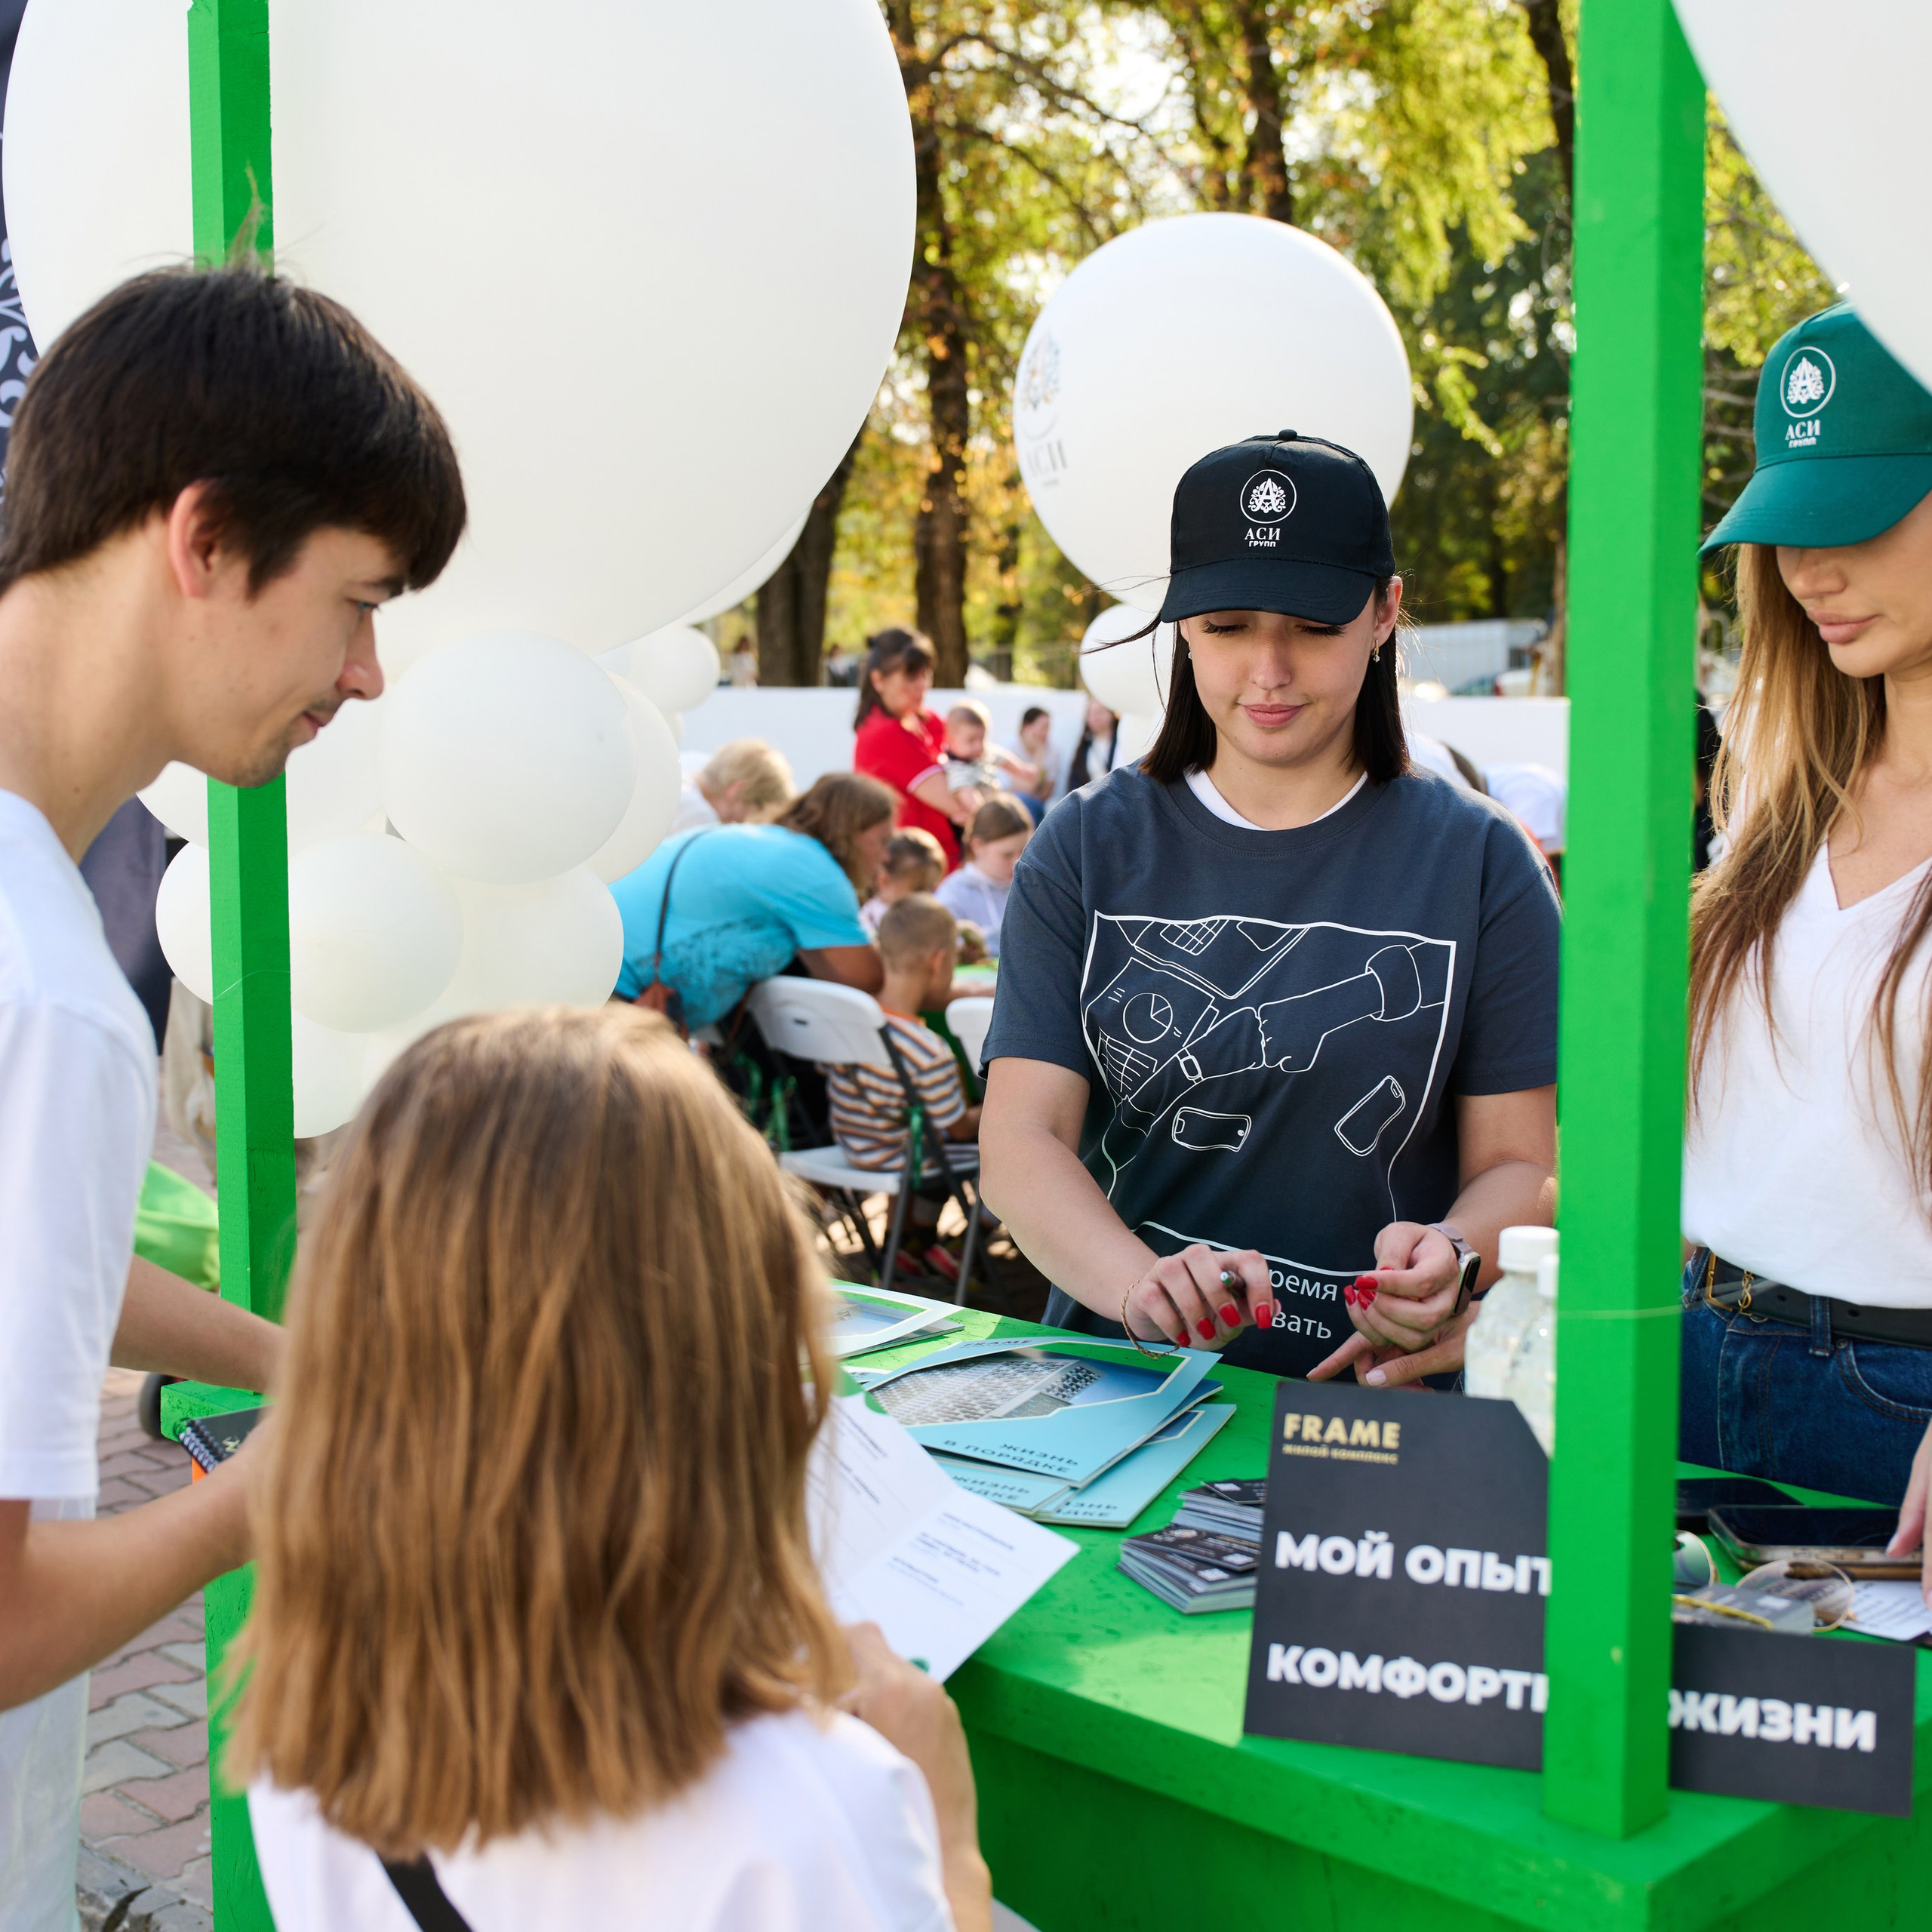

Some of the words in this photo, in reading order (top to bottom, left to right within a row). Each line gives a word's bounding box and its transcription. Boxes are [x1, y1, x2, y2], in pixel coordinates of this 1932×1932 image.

[1785, 419, 1821, 440] АСИ
[1244, 528, 1281, 540] АСИ
[1269, 1269, 1337, 1301] ремя
[1272, 1312, 1332, 1340] вать
[1283, 1413, 1401, 1450] FRAME
[964, 1444, 1070, 1472] ПОРЯДКЕ
[1000, 1443, 1078, 1466] ЖИЗНЬ
[952, 1475, 1029, 1494] ЖИЗНЬ
[1275, 1530, 1395, 1580] МОЙ
[1405, 1544, 1552, 1597] ОПЫТ
[1668, 1688, 1877, 1752] ЖИЗНИ
